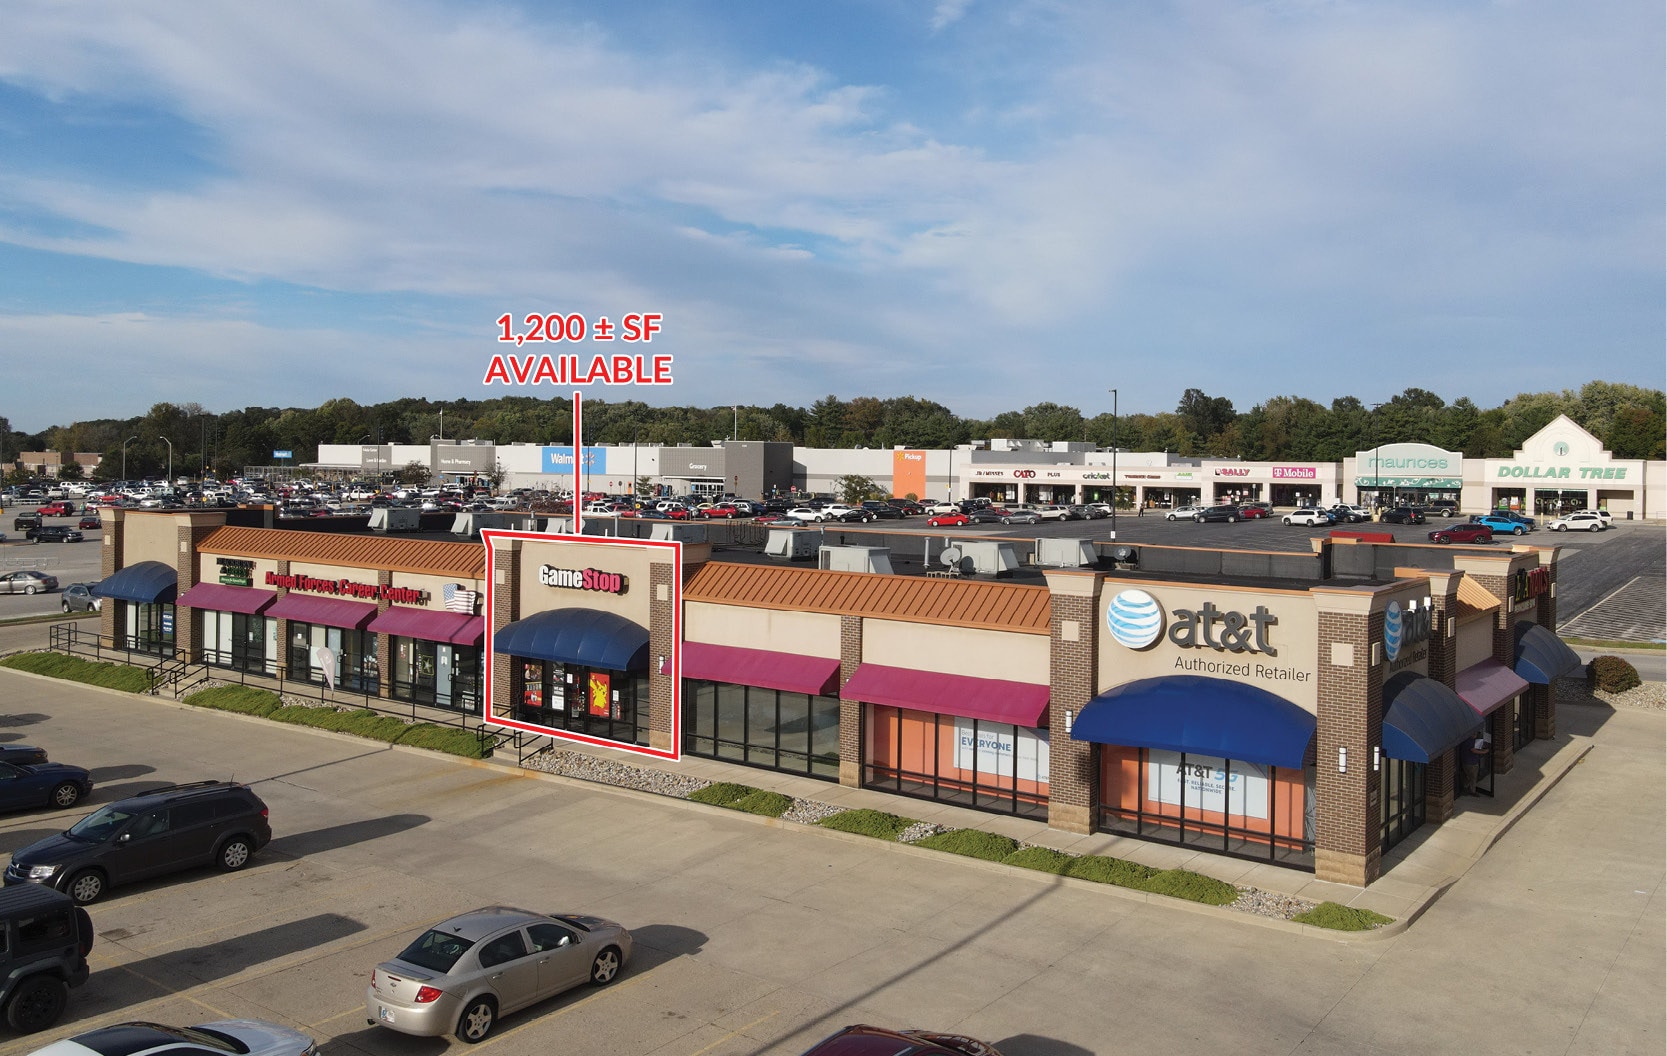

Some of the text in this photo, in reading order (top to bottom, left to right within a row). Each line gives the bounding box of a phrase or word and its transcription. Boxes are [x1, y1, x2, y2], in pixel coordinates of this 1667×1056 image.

[551, 452, 584, 465] Walmt
[904, 453, 922, 461] Pickup
[688, 462, 708, 471] Grocery
[1220, 468, 1250, 476] SALLY
[1497, 466, 1627, 480] DOLLAR TREE
[1013, 469, 1036, 479] CATO
[1082, 472, 1111, 480] cricket
[538, 565, 622, 593] GameStop
[265, 571, 297, 588] Armed
[299, 574, 335, 593] Forces
[339, 579, 378, 598] Career
[380, 584, 420, 603] Center
[1168, 601, 1277, 655] at&t
[1174, 656, 1312, 682] Authorized Retailer
